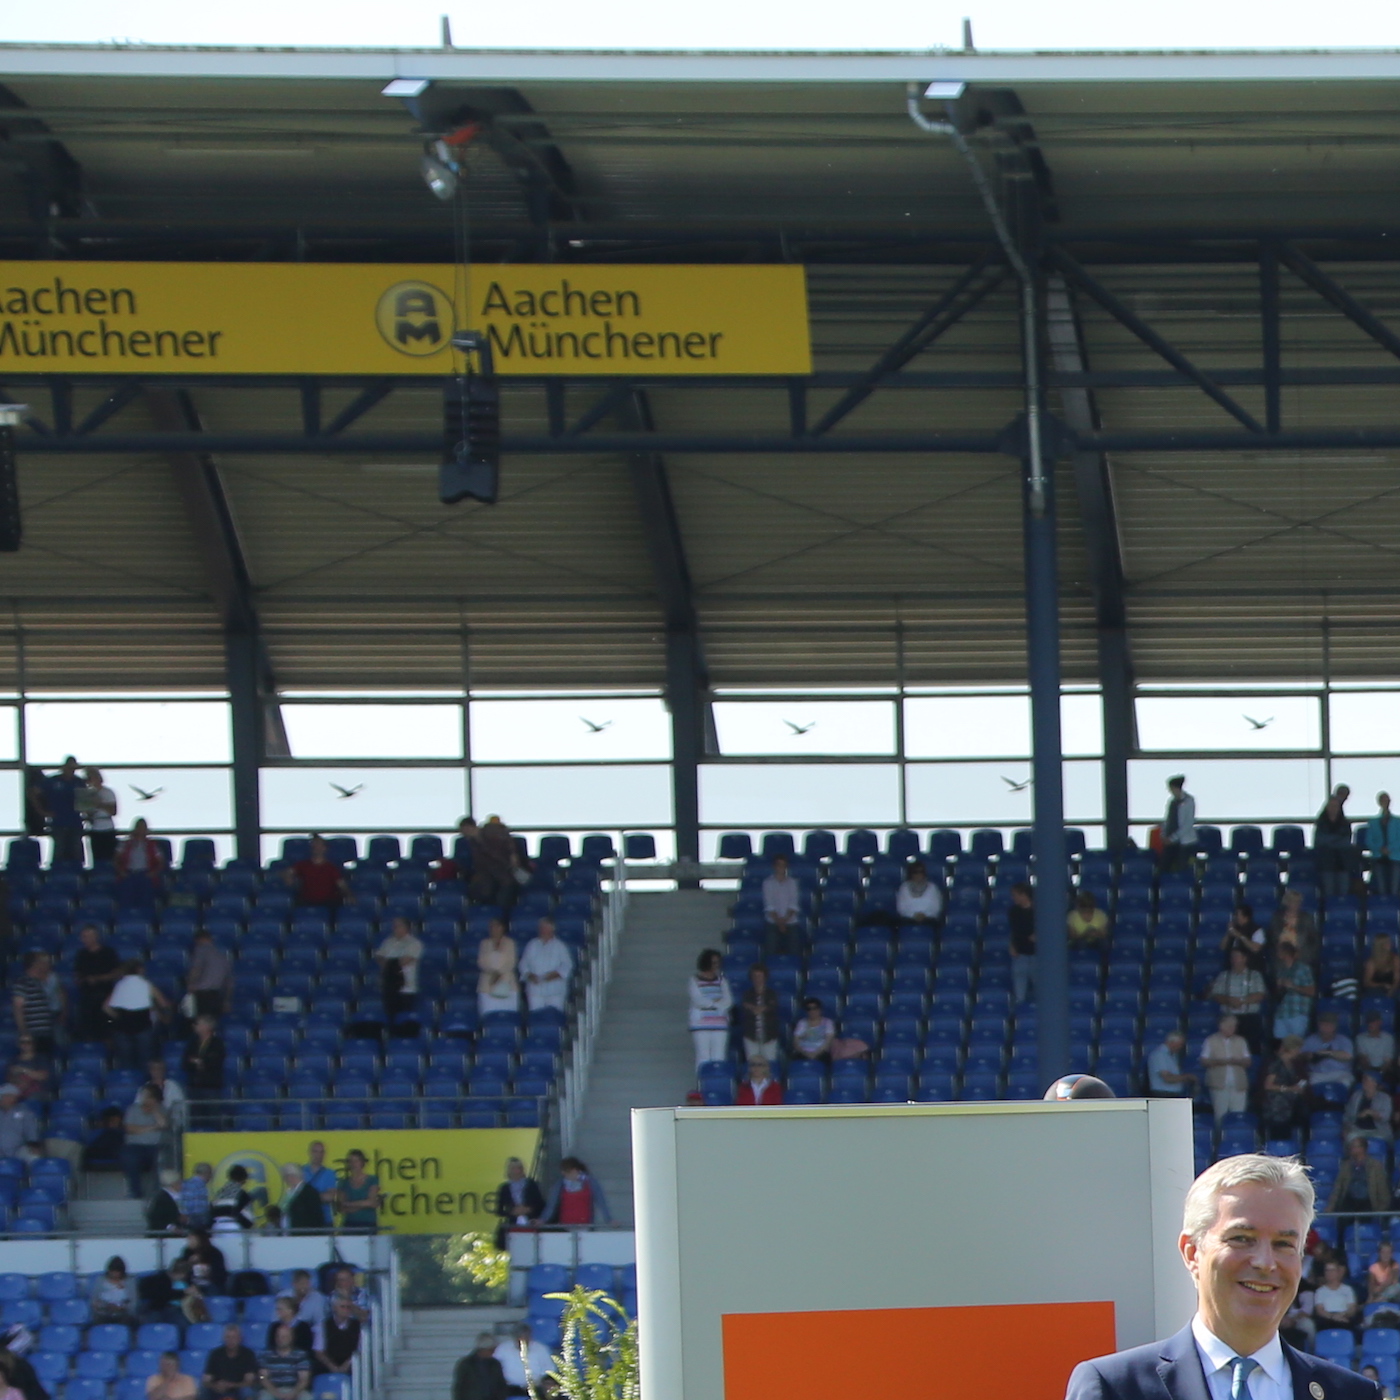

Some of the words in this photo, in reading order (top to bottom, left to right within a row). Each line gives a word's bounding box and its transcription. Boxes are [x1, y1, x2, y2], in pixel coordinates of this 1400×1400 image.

[0, 277, 137, 315] achen
[481, 279, 640, 317] Aachen
[486, 322, 723, 359] Münchener
